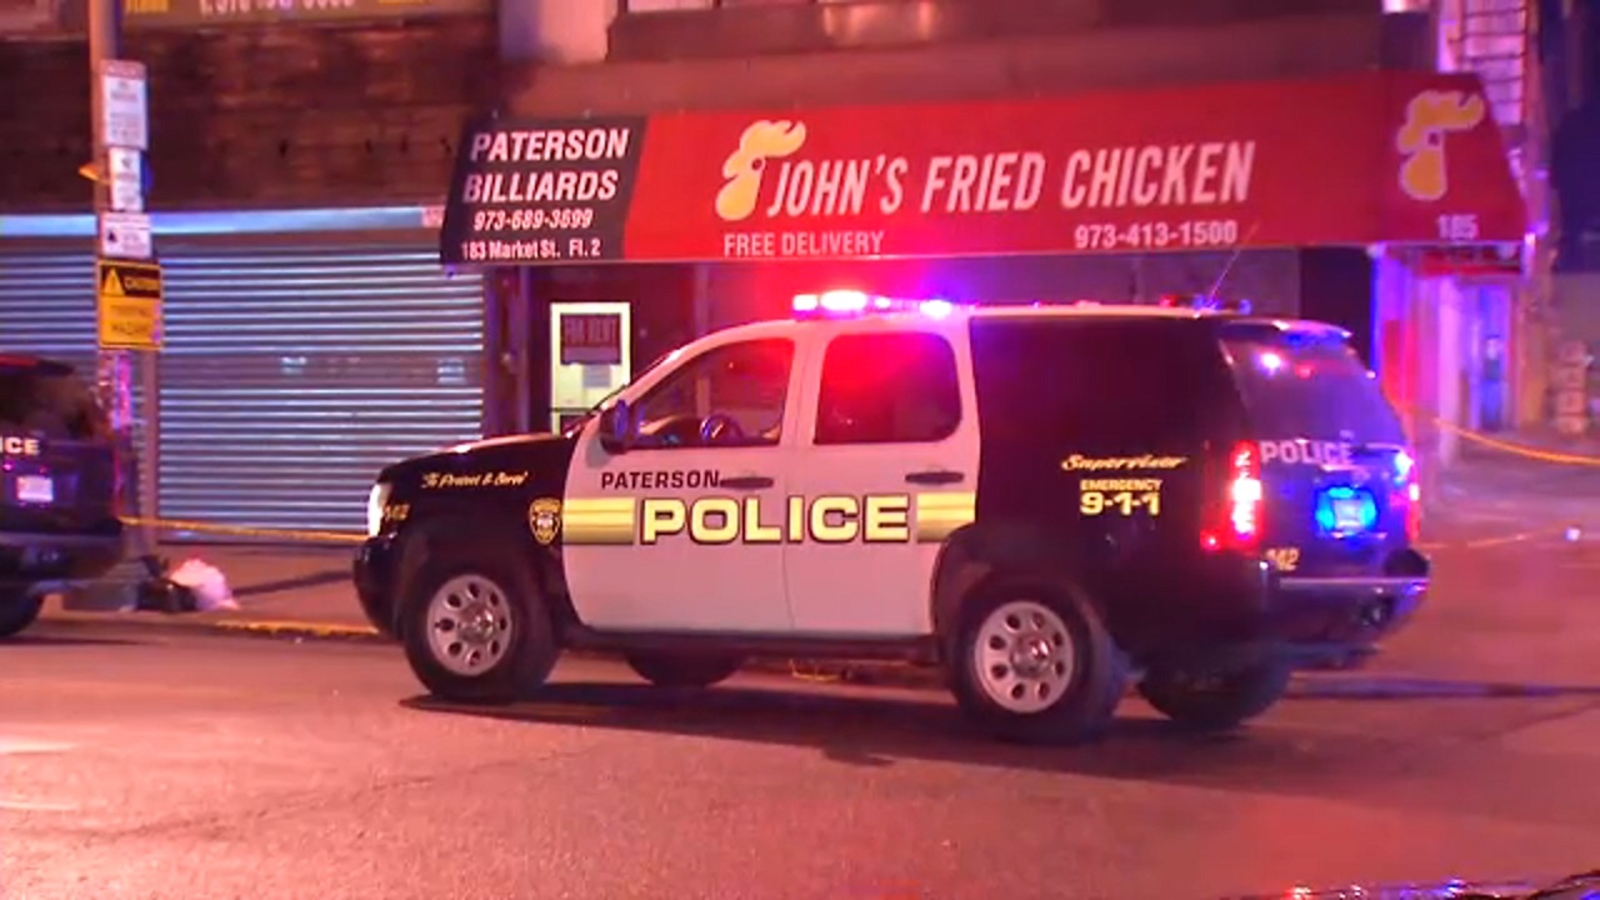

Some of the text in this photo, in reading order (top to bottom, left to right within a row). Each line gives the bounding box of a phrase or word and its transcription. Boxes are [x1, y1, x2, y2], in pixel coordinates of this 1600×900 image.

[470, 128, 629, 161] PATERSON
[463, 170, 618, 203] BILLIARDS
[767, 140, 1256, 217] JOHN'S FRIED CHICKEN
[724, 230, 884, 256] FREE DELIVERY
[1074, 220, 1238, 248] 973-413-1500
[462, 241, 486, 260] 183
[489, 240, 538, 259] Market
[591, 237, 601, 256] 2
[1259, 441, 1352, 466] POLICE
[601, 470, 720, 489] PATERSON
[1080, 479, 1163, 491] EMERGENCY
[1080, 491, 1160, 516] 9-1-1
[640, 495, 910, 544] POLICE
